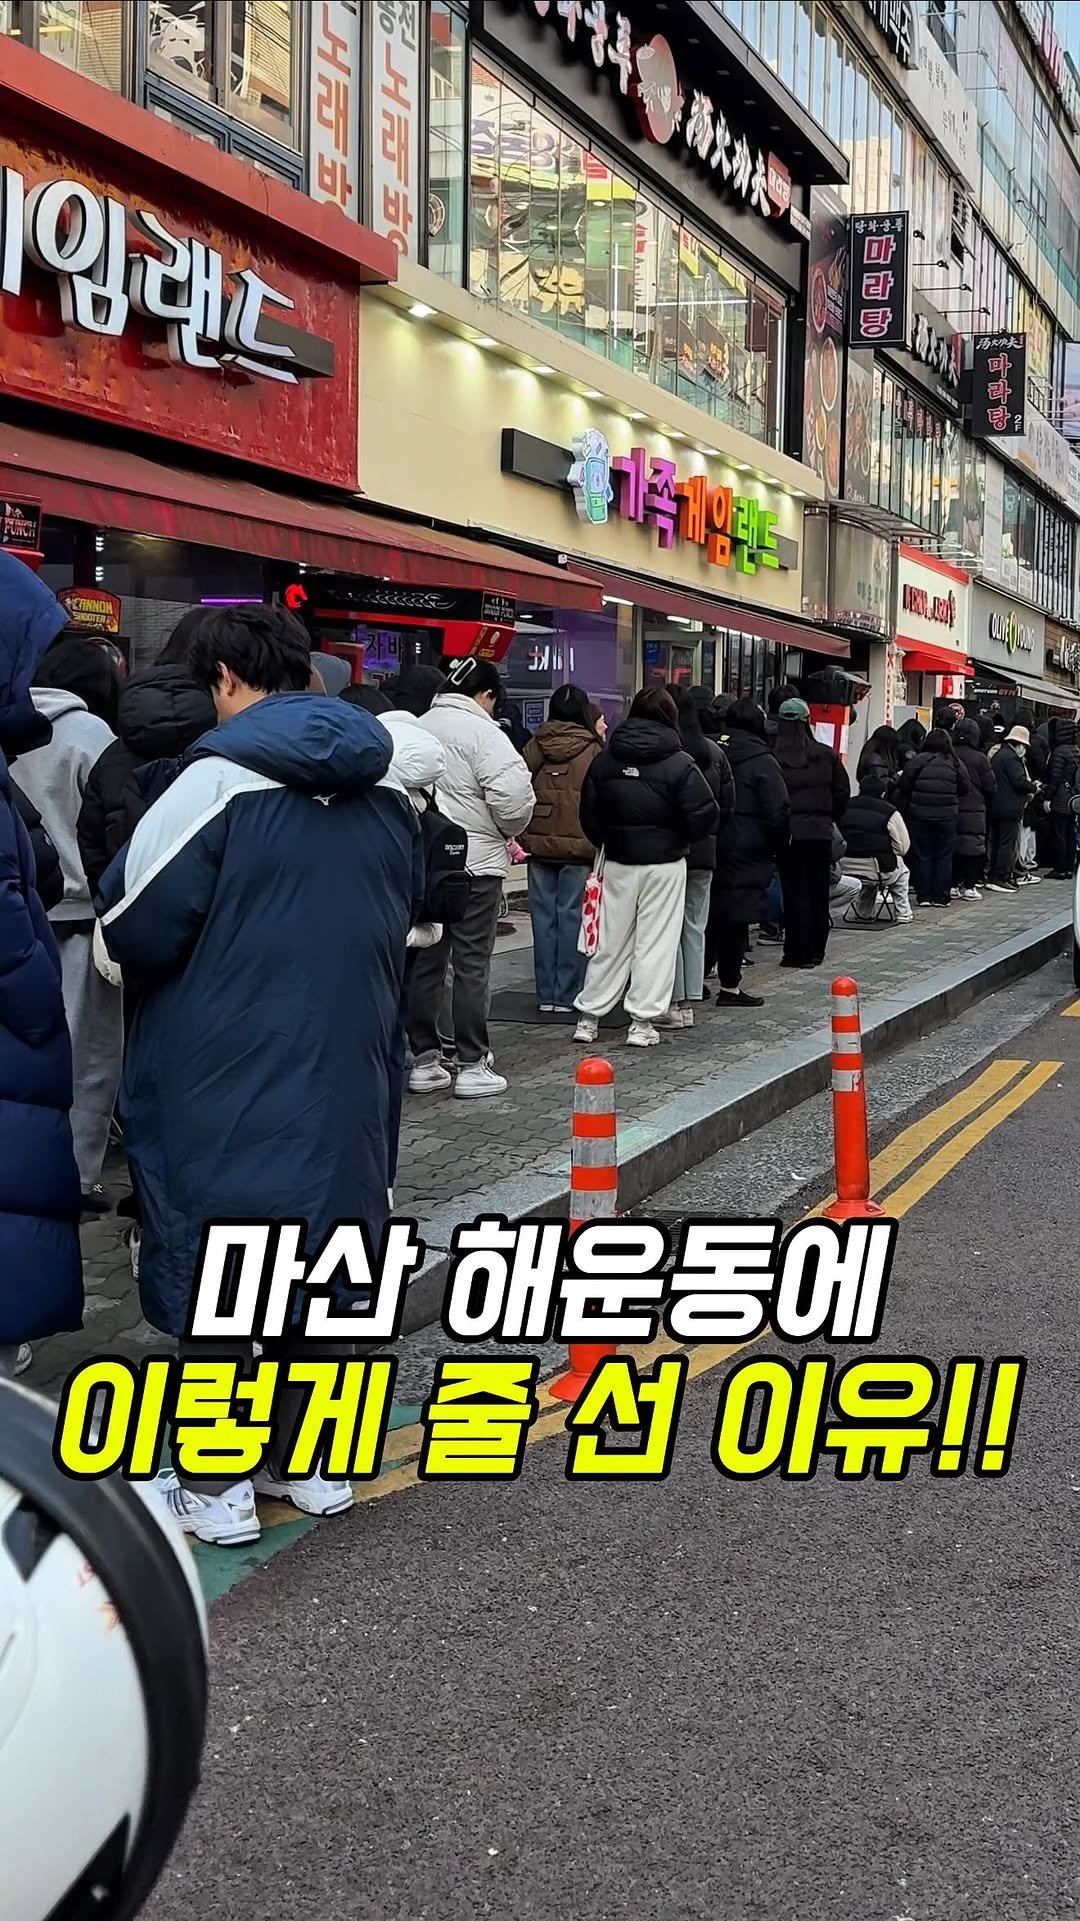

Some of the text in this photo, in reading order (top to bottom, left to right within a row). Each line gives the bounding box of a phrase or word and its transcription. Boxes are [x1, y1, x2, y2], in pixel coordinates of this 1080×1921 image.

[381, 40, 413, 257] 노래방
[1, 166, 300, 385] 임랜드
[859, 234, 897, 338] 마라탕
[986, 353, 1012, 431] 마라탕
[1014, 414, 1022, 432] 2F
[611, 447, 779, 576] 가족게임랜드
